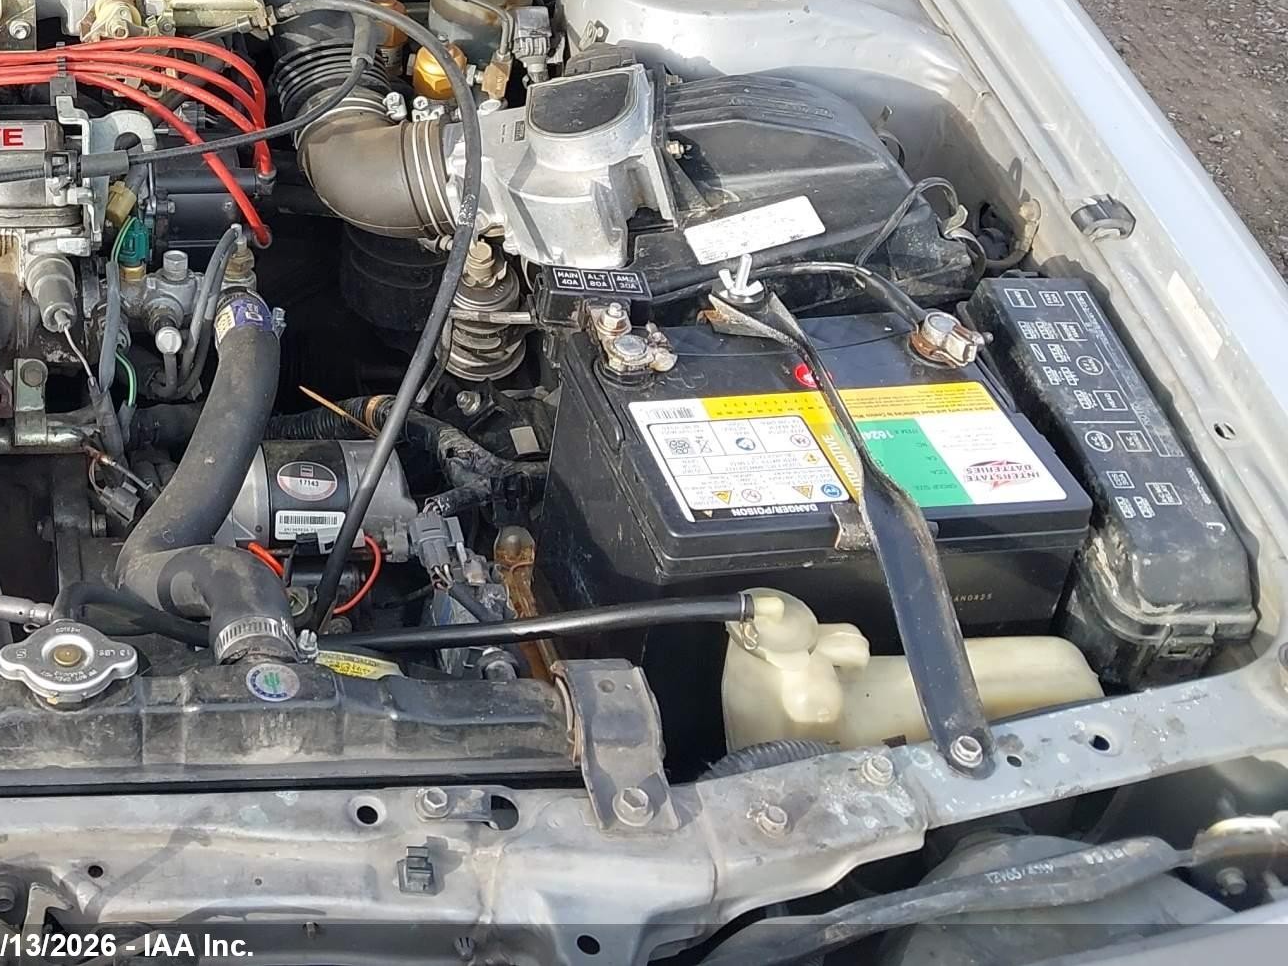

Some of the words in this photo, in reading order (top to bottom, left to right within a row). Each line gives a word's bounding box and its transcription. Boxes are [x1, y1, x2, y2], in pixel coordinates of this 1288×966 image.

[557, 271, 579, 279] MAIN
[966, 464, 1032, 474] BATTERIES
[967, 472, 1040, 482] INTERSTATE
[732, 504, 818, 516] DANGER/POISON
